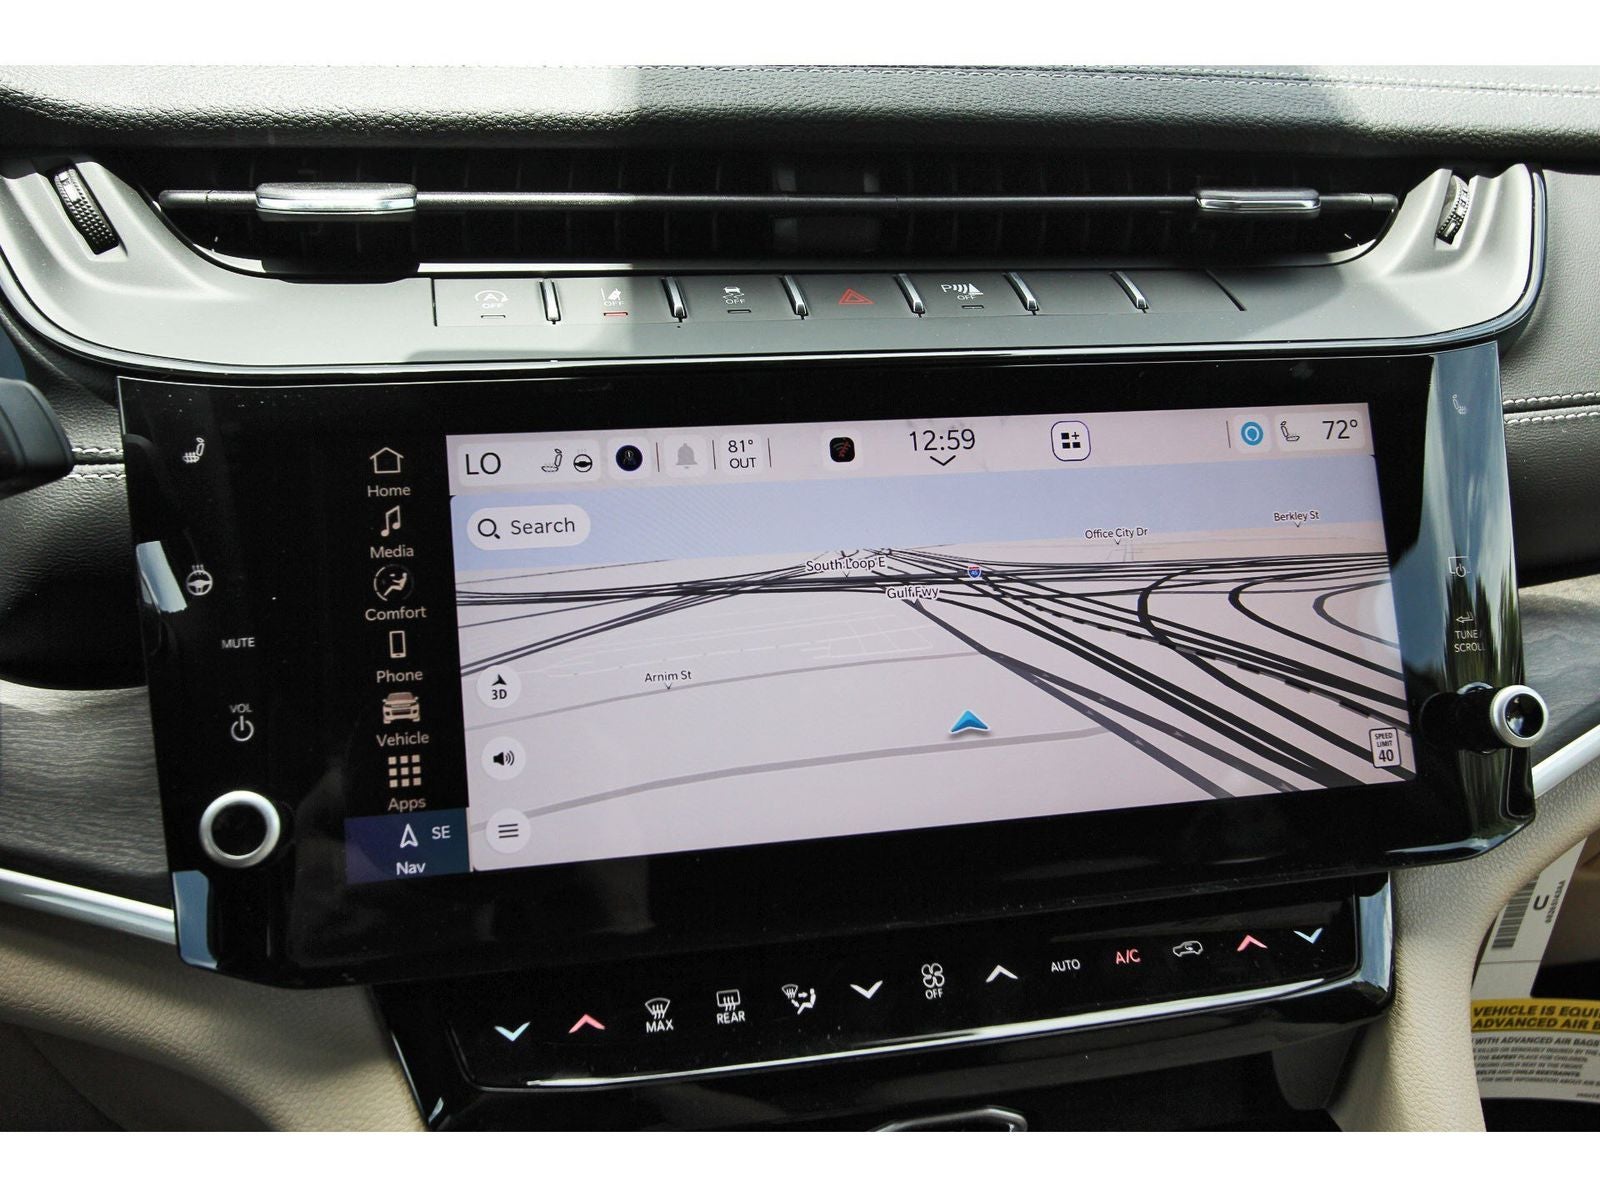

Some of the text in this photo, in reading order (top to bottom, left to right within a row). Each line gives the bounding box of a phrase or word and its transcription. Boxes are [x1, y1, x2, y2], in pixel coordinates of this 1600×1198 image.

[1322, 418, 1358, 440] 72°
[728, 439, 754, 453] 81°
[909, 428, 976, 452] 12:59
[465, 451, 502, 475] LO
[729, 457, 757, 469] OUT
[367, 484, 411, 497] Home
[1274, 510, 1320, 523] Berkley St
[510, 517, 576, 536] Search
[1085, 527, 1148, 540] Office City Dr
[370, 545, 414, 559] Media
[806, 557, 886, 572] South Loop E
[886, 586, 940, 600] Gulf Fwy
[365, 605, 427, 621] Comfort
[222, 636, 256, 649] MUTE
[376, 670, 424, 683] Phone
[644, 670, 692, 683] Arnim St
[491, 688, 507, 700] 3D
[229, 704, 253, 714] VOL
[376, 731, 430, 748] Vehicle
[1375, 732, 1393, 740] SPEED
[1378, 749, 1394, 762] 40
[387, 797, 426, 813] Apps
[431, 825, 451, 840] SE
[396, 861, 426, 876] Nav
[1115, 948, 1141, 964] A/C
[1051, 959, 1081, 973] AUTO
[925, 988, 943, 1000] OFF
[716, 1010, 746, 1025] REAR
[1473, 1005, 1538, 1017] VEHICLE
[1540, 1005, 1557, 1016] IS
[645, 1018, 674, 1034] MAX
[1472, 1018, 1559, 1029] ADVANCED
[1560, 1019, 1590, 1030] AIR
[1475, 1037, 1500, 1045] WITH
[1500, 1036, 1553, 1045] ADVANCED
[1554, 1037, 1573, 1046] AIR
